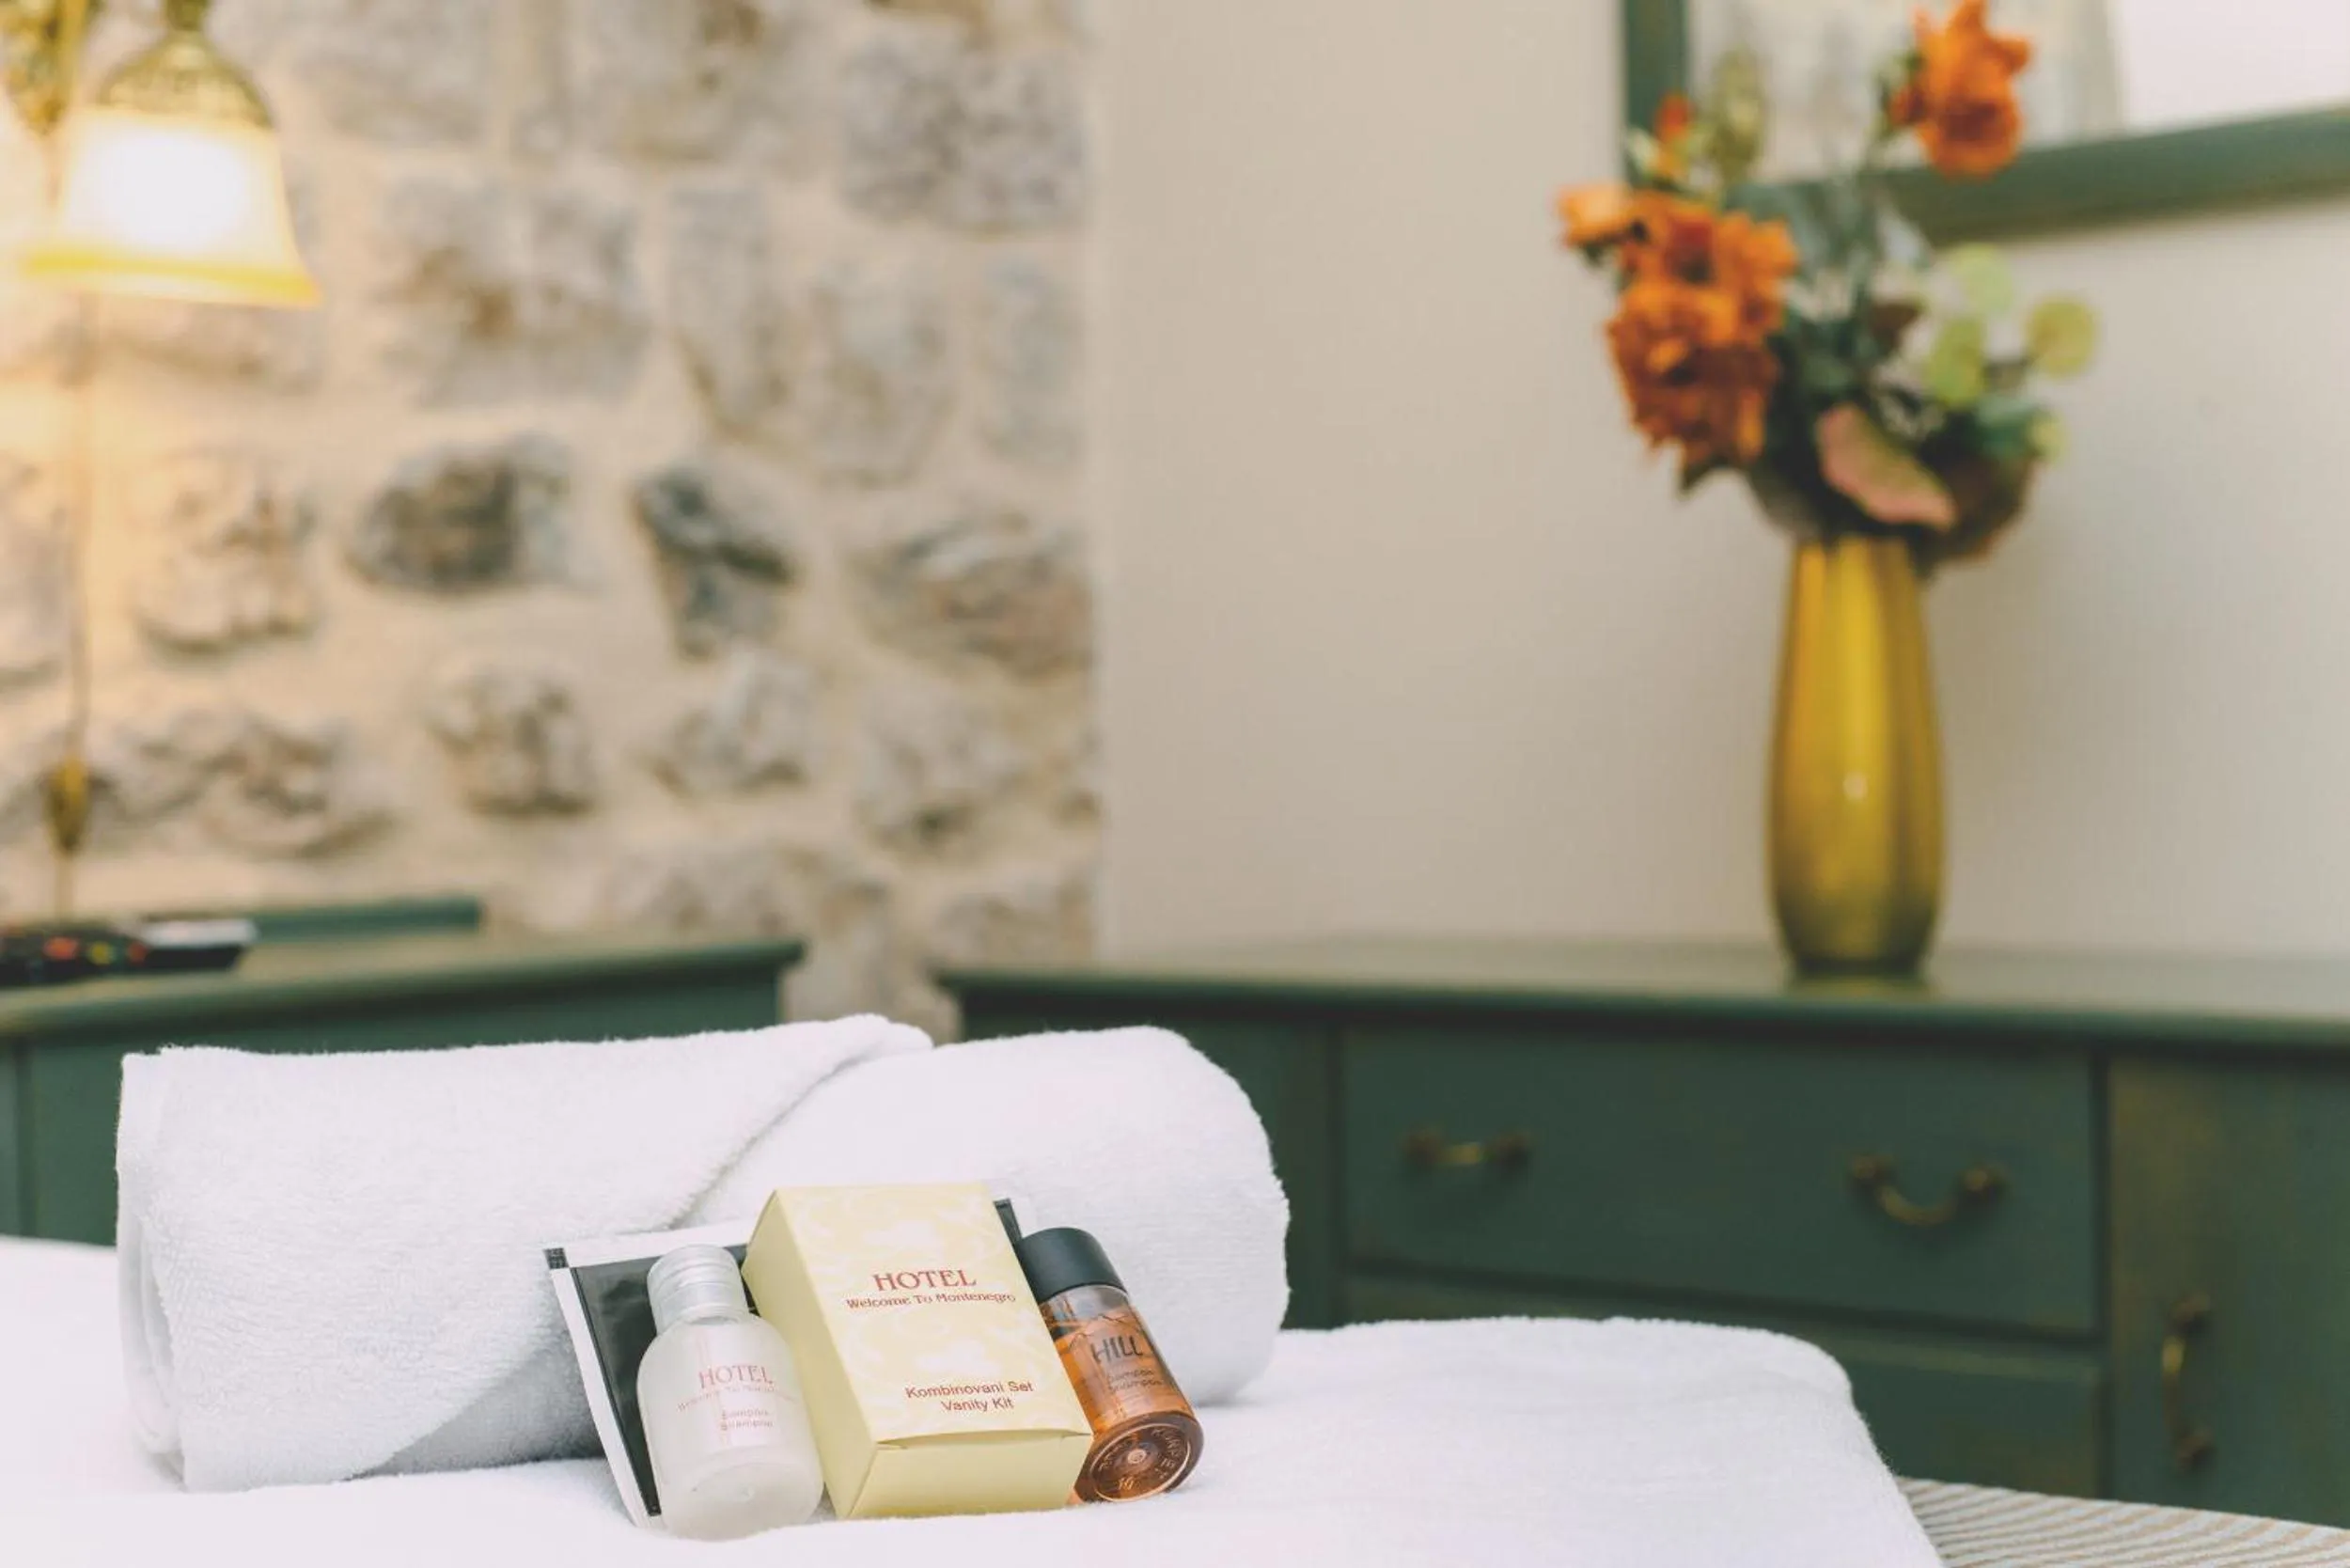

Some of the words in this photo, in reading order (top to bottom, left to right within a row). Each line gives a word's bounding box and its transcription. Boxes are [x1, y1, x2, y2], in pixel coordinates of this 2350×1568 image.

[872, 1270, 978, 1291] HOTEL
[846, 1296, 910, 1309] Welcome
[914, 1294, 932, 1304] To
[936, 1292, 1017, 1304] Montenegro
[1090, 1335, 1143, 1362] HILL
[699, 1364, 773, 1388] HOTEL
[905, 1383, 1005, 1398] Kombinovani
[1009, 1381, 1034, 1392] Set
[941, 1398, 989, 1411] Vanity
[993, 1397, 1015, 1409] Kit
